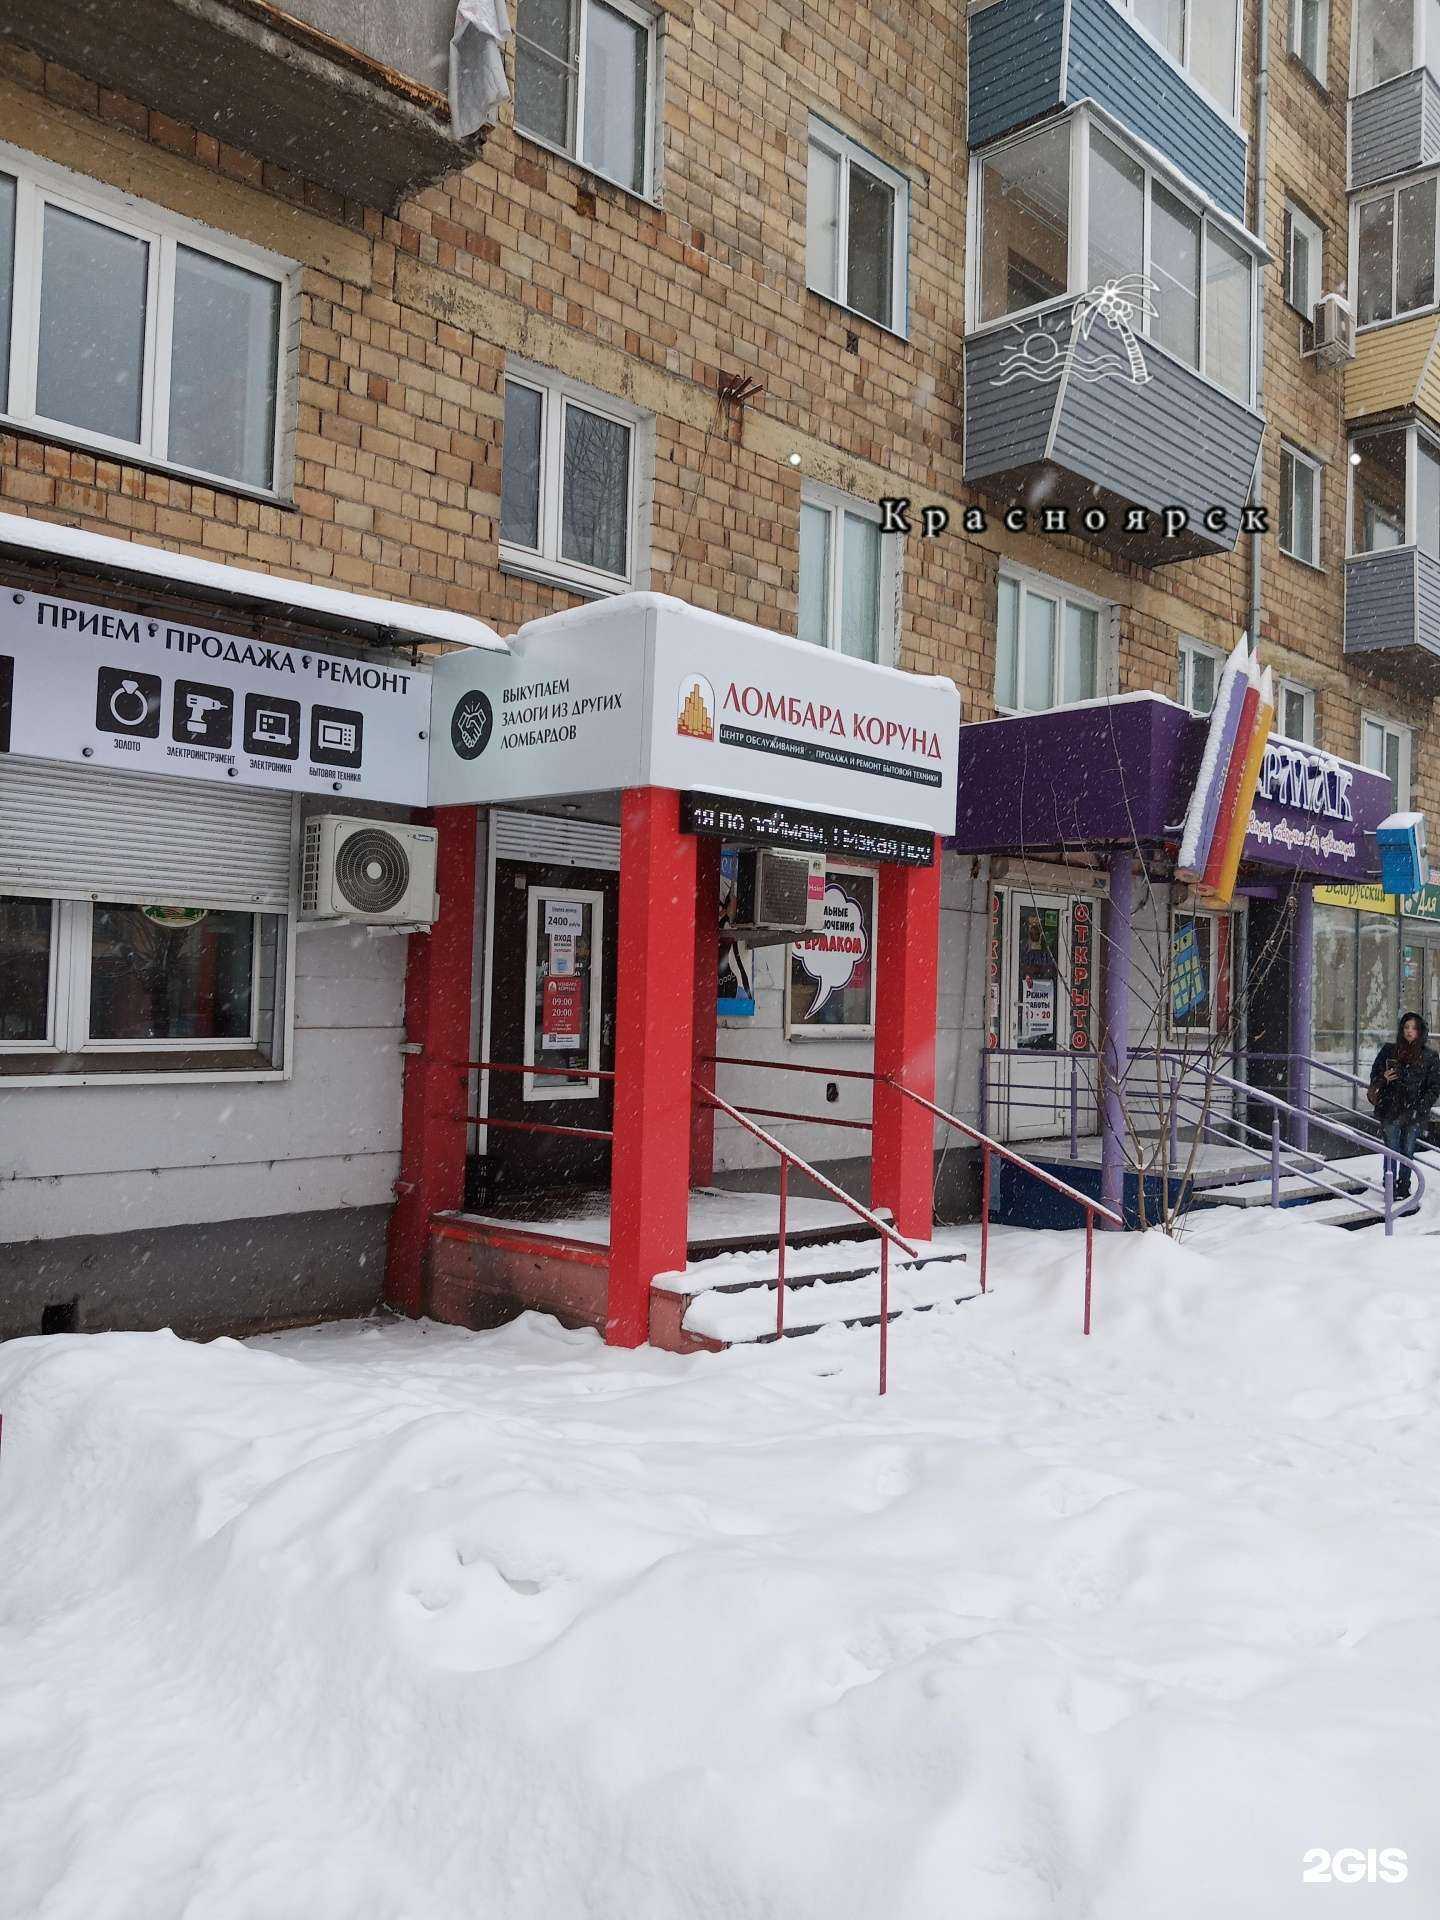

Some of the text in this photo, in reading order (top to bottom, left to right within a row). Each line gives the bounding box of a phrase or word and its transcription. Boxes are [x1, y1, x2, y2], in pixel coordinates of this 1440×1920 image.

[37, 602, 411, 695] ПРИЕМ ПРОДАЖА РЕМОНТ
[502, 678, 570, 704] ВЫКУПАЕМ
[502, 693, 623, 727] ЗАЛОГИ ИЗ ДРУГИХ
[723, 682, 943, 760] ЛОМБАРД КОРУНД
[114, 738, 141, 752] ЗОЛОТО
[501, 725, 577, 749] ЛОМБАРДОВ
[166, 746, 236, 765] ЭЛЕКТРОИНСТРУМЕНТ
[720, 727, 939, 783] ЦЕНТР ОБСЛУЖИВАНИЯ ПРОДАЖА И РЕМОНТ БЫТОВОЙ ТЕХНИКИ
[249, 758, 292, 774] ЭЛЕКТРОНИКА
[309, 766, 362, 783] БЫТОВАЯ ТЕХНИКА
[1417, 888, 1437, 915] Для
[548, 916, 568, 926] 2400
[554, 934, 572, 942] ВХОД
[805, 934, 863, 954] ЕРМАКОМ
[1071, 903, 1091, 1049] ОТКРЫТО
[552, 997, 572, 1006] 09:00
[551, 1008, 572, 1017] 20:00
[1042, 1010, 1051, 1019] 20
